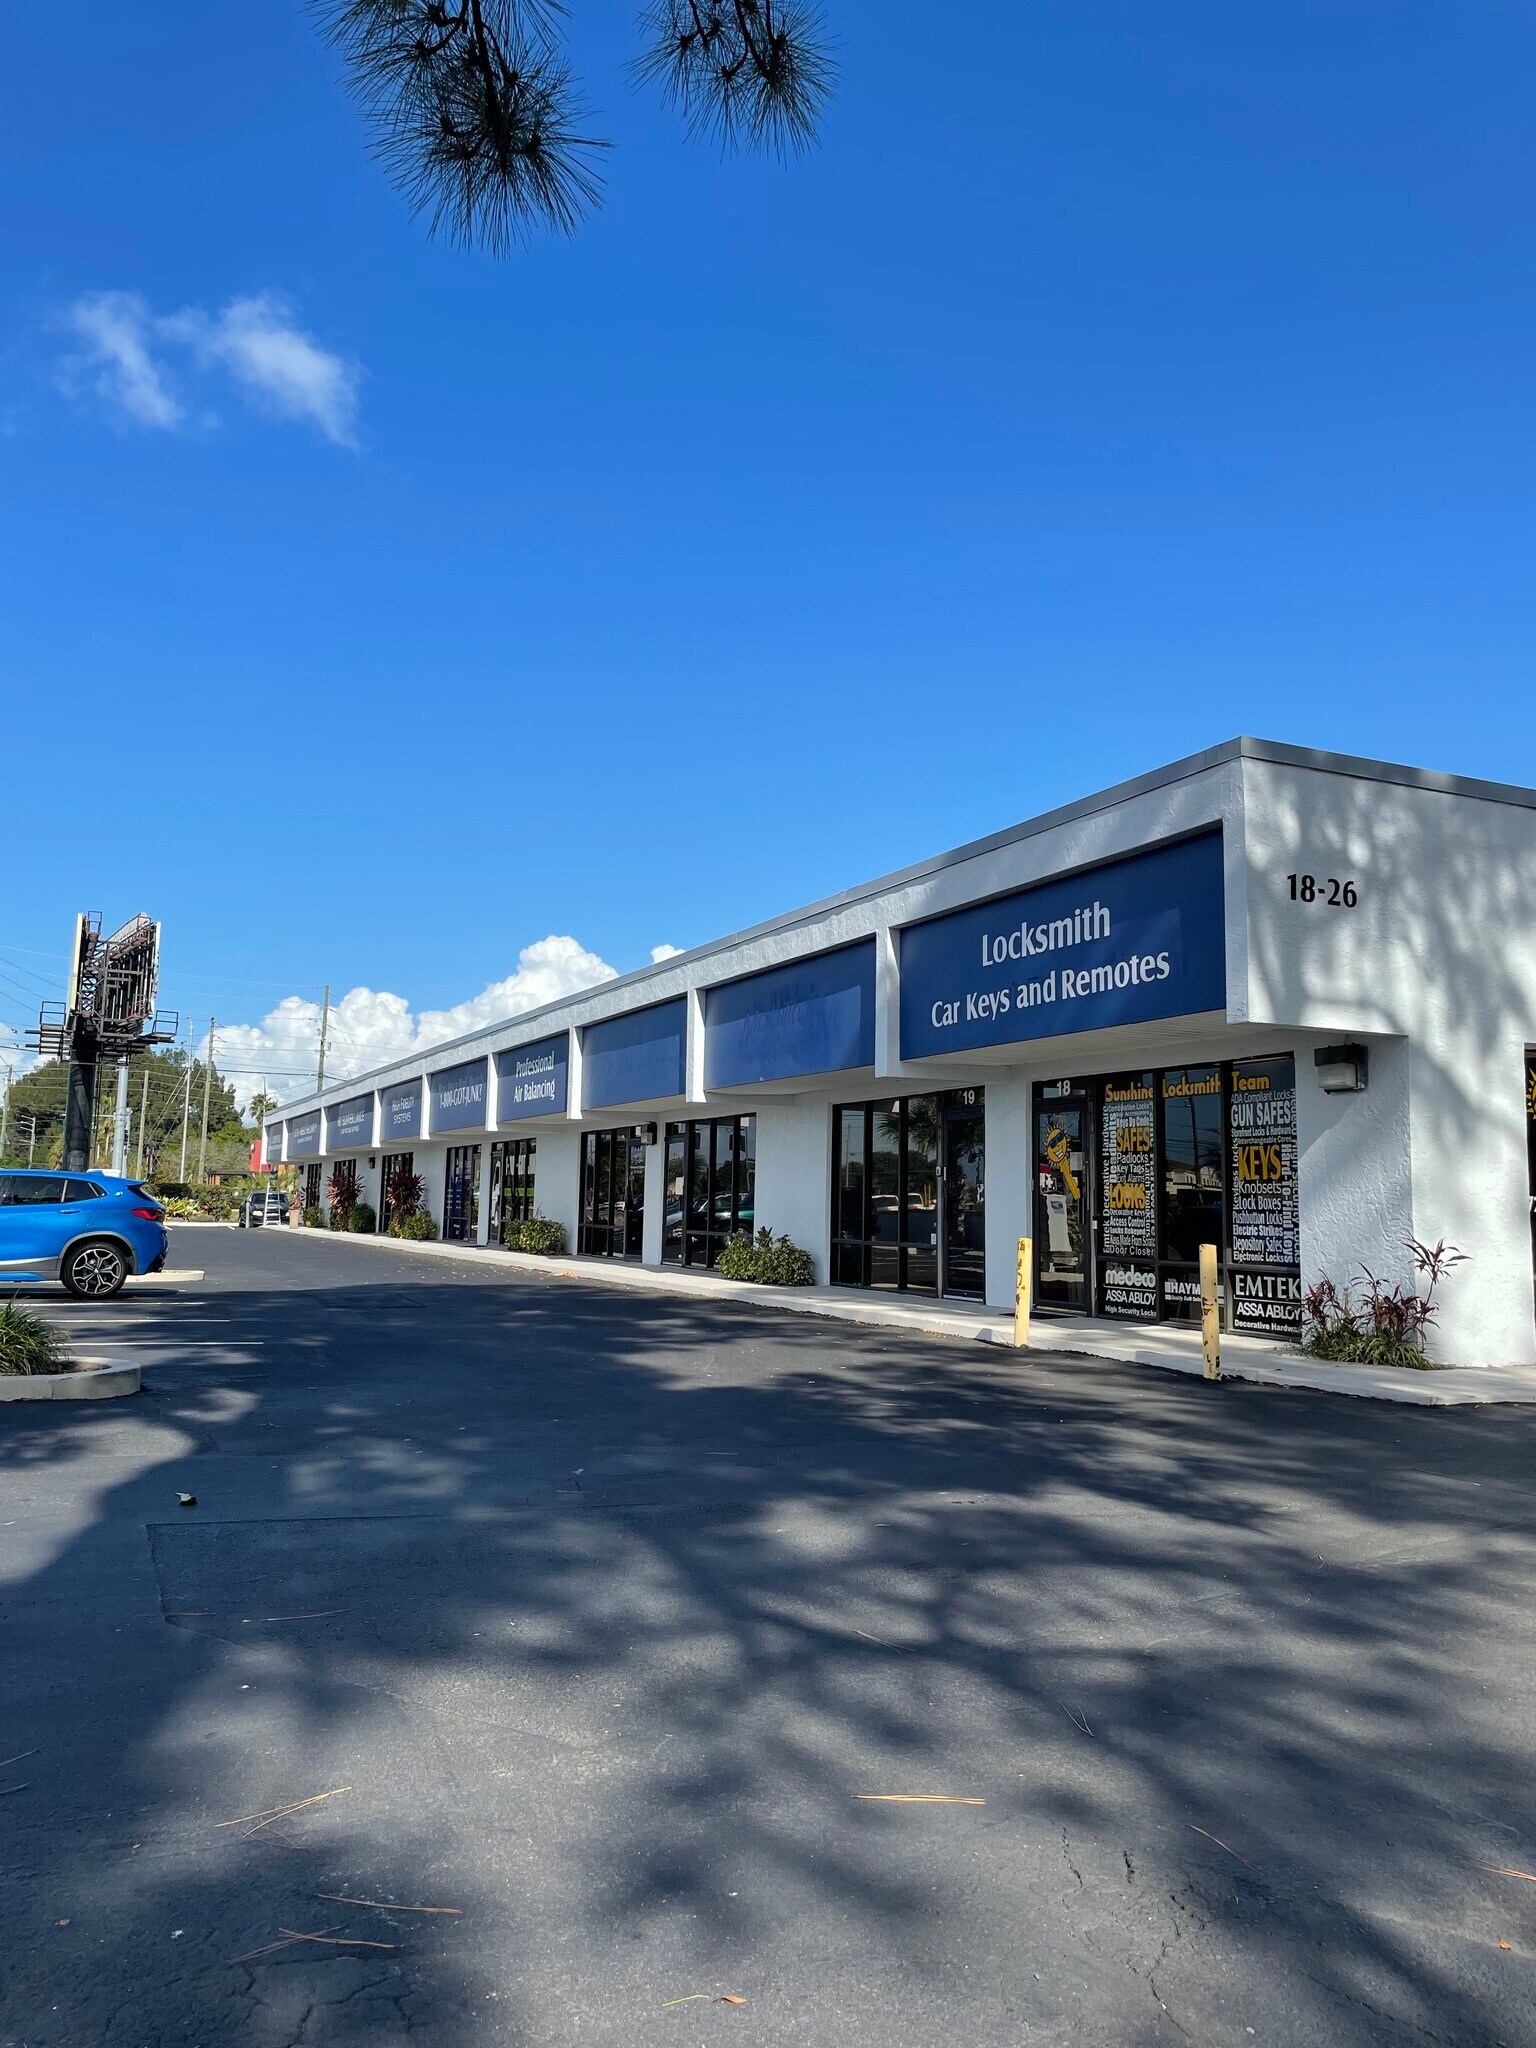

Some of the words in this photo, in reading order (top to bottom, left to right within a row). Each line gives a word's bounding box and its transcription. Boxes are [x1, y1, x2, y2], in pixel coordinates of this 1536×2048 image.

[1287, 873, 1358, 908] 18-26
[982, 901, 1111, 967] Locksmith
[931, 999, 960, 1028] Car
[966, 988, 1010, 1021] Keys
[1016, 970, 1056, 1009] and
[1061, 951, 1171, 1000] Remotes
[515, 1051, 555, 1079] Professional
[513, 1085, 522, 1103] Air
[523, 1078, 556, 1101] Balancing
[1057, 1080, 1071, 1096] 18
[1105, 1081, 1154, 1102] Sunshine
[1162, 1072, 1221, 1098] Locksmith
[1231, 1071, 1270, 1091] Team
[963, 1090, 975, 1105] 19
[1231, 1094, 1243, 1104] ADA
[1243, 1091, 1273, 1103] Compliant
[1273, 1088, 1291, 1101] Locks
[1136, 1102, 1150, 1110] Locks
[1231, 1103, 1254, 1127] GUN
[1256, 1100, 1291, 1125] SAFES
[1102, 1105, 1110, 1156] Hardware
[1116, 1127, 1150, 1152] SAFES
[1109, 1112, 1117, 1183] Deadbolts
[1116, 1152, 1149, 1164] Padlocks
[1238, 1144, 1282, 1180] KEYS
[1116, 1164, 1128, 1174] Key
[1129, 1163, 1145, 1174] Tags
[1127, 1173, 1145, 1182] Alarms
[1102, 1159, 1110, 1217] Decorative
[1239, 1180, 1282, 1194] Knobsets
[1281, 1143, 1294, 1228] Hard-To-Find
[1109, 1182, 1146, 1209] LOCKS
[1239, 1194, 1256, 1210] Lock
[1257, 1195, 1281, 1210] Boxes
[1109, 1215, 1127, 1227] Access
[1127, 1216, 1146, 1227] Control
[1232, 1210, 1265, 1225] Pushbutton
[1265, 1210, 1283, 1225] Locks
[1102, 1220, 1110, 1254] Emtek
[1233, 1224, 1258, 1236] Electric
[1258, 1225, 1284, 1236] Strikes
[1109, 1244, 1128, 1255] Door
[1233, 1236, 1265, 1254] Depository
[1265, 1236, 1283, 1252] Safes
[1283, 1230, 1294, 1263] Keys
[1233, 1250, 1265, 1262] Electronic
[1265, 1252, 1284, 1263] Locks
[1105, 1264, 1156, 1288] medeco
[1171, 1282, 1201, 1295] HAYM
[1235, 1274, 1300, 1300] EMTEK
[1105, 1289, 1128, 1303] ASSA
[1128, 1291, 1156, 1306] ABLOY
[1105, 1305, 1117, 1314] High
[1118, 1306, 1140, 1317] Security
[1141, 1309, 1157, 1317] Locks
[1236, 1301, 1265, 1317] ASSA
[1265, 1304, 1300, 1320] ABLOY
[1234, 1319, 1270, 1330] Decorative
